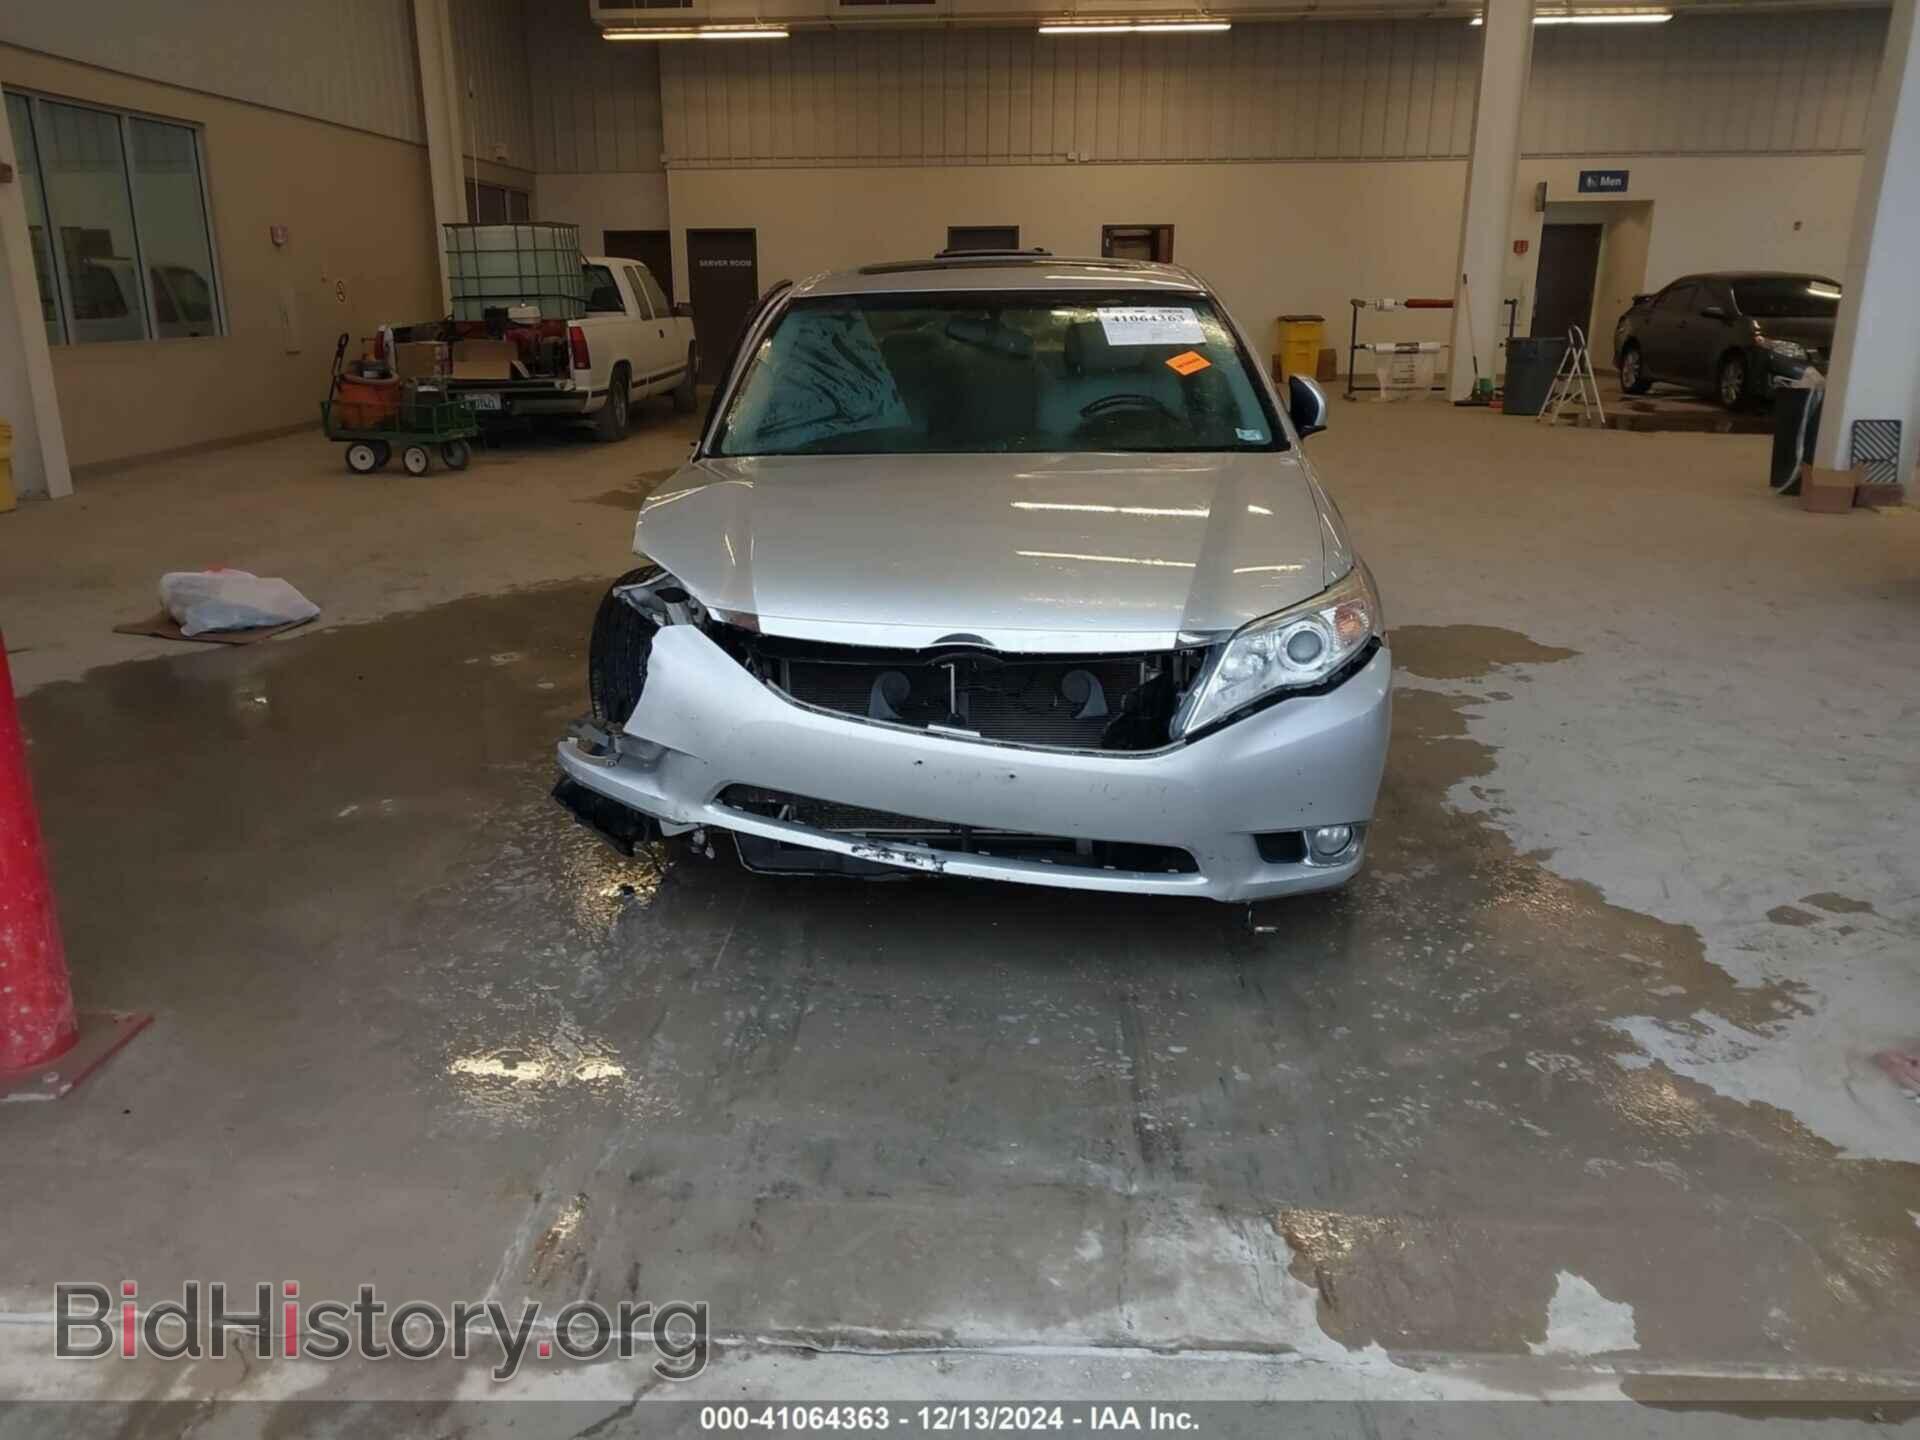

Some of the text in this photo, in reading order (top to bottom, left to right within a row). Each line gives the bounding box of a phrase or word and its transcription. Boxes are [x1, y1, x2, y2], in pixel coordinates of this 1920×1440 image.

[1600, 175, 1622, 186] Men
[699, 259, 752, 267] SERVER ROOM
